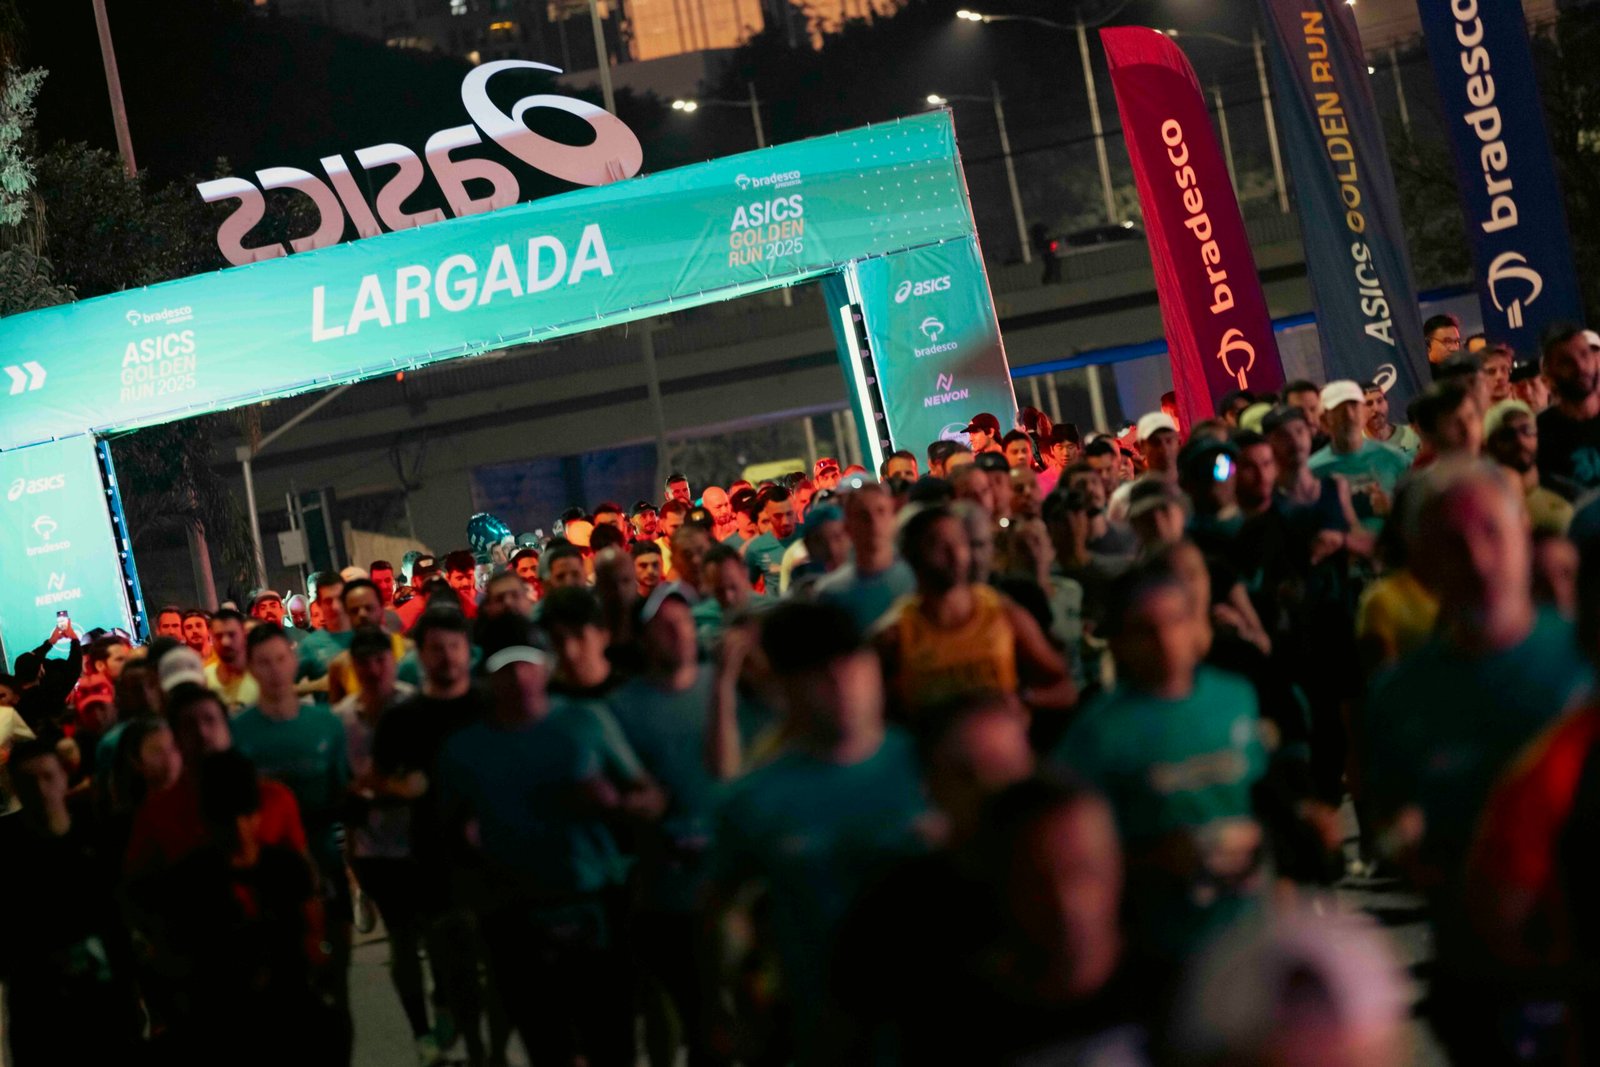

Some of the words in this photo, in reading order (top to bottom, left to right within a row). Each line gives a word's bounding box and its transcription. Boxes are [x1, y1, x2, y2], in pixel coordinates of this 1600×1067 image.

[1301, 11, 1334, 83] RUN
[1451, 0, 1518, 233] bradesco
[752, 169, 801, 188] bradesco
[1314, 92, 1365, 234] GOLDEN
[730, 194, 804, 231] ASICS
[1161, 118, 1235, 315] bradesco
[729, 218, 804, 250] GOLDEN
[729, 245, 763, 268] RUN
[765, 237, 804, 260] 2025
[312, 223, 613, 342] LARGADA
[1351, 242, 1395, 346] ASICS
[143, 306, 192, 323] bradesco
[122, 330, 195, 367] ASICS
[914, 341, 958, 358] bradesco
[121, 354, 196, 385] GOLDEN
[119, 381, 154, 403] RUN
[157, 373, 196, 397] 2025
[923, 388, 969, 408] NEWON
[27, 541, 70, 556] bradesco
[35, 588, 81, 607] NEWON
